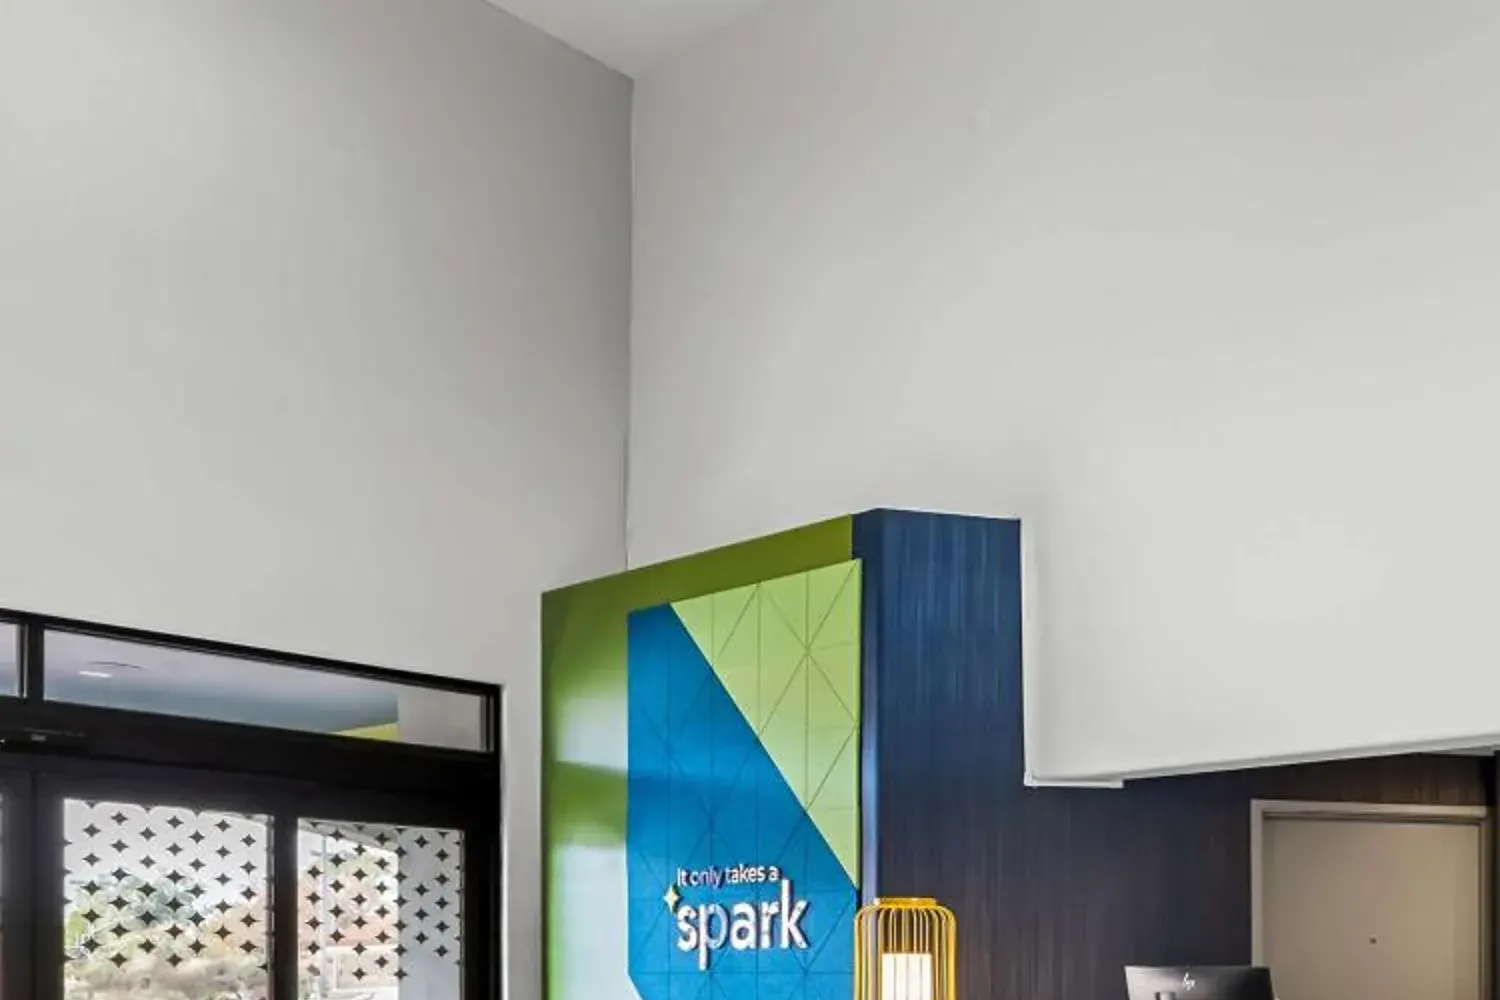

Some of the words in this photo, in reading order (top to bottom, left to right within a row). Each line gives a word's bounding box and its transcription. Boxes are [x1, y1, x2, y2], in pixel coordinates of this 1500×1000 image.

[676, 867, 687, 888] It
[689, 865, 721, 889] only
[725, 863, 766, 883] takes
[768, 865, 780, 882] a
[676, 877, 810, 971] spark
